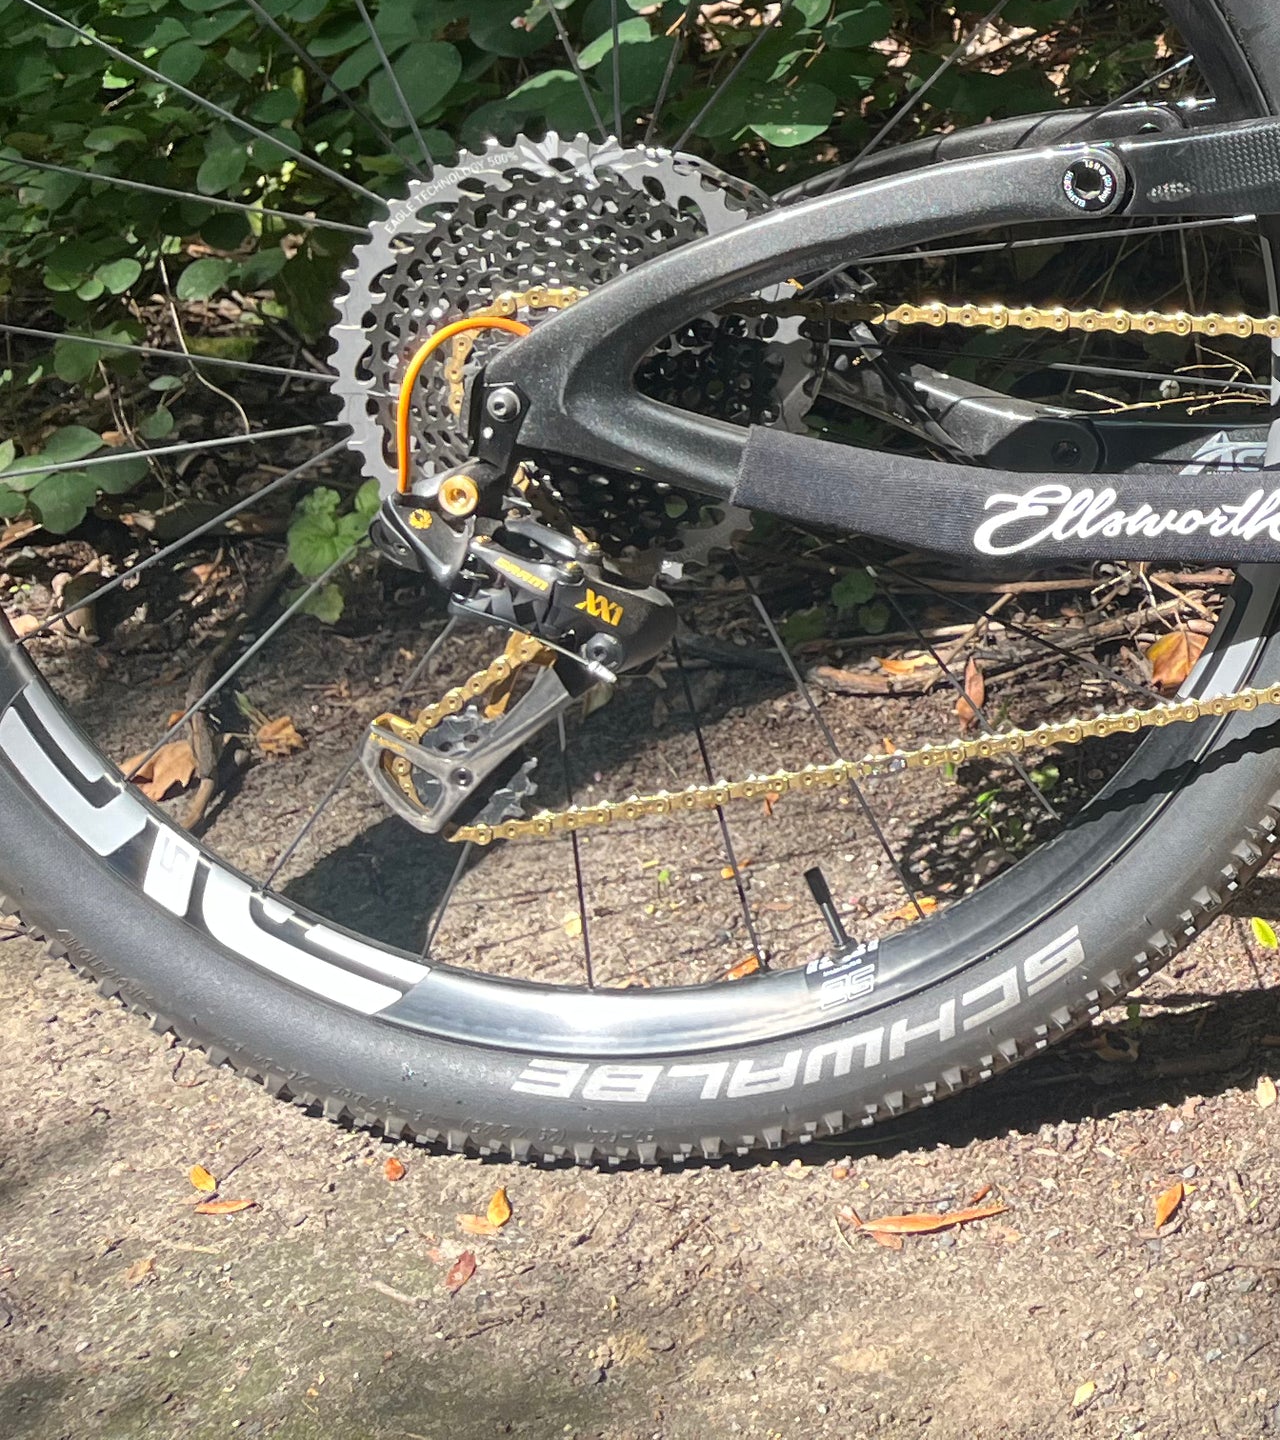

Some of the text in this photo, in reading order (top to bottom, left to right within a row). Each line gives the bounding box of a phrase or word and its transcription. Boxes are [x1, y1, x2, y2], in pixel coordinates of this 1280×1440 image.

[494, 557, 549, 591] SRAM
[575, 588, 624, 627] XX1
[511, 924, 1087, 1103] SCHWALBE
